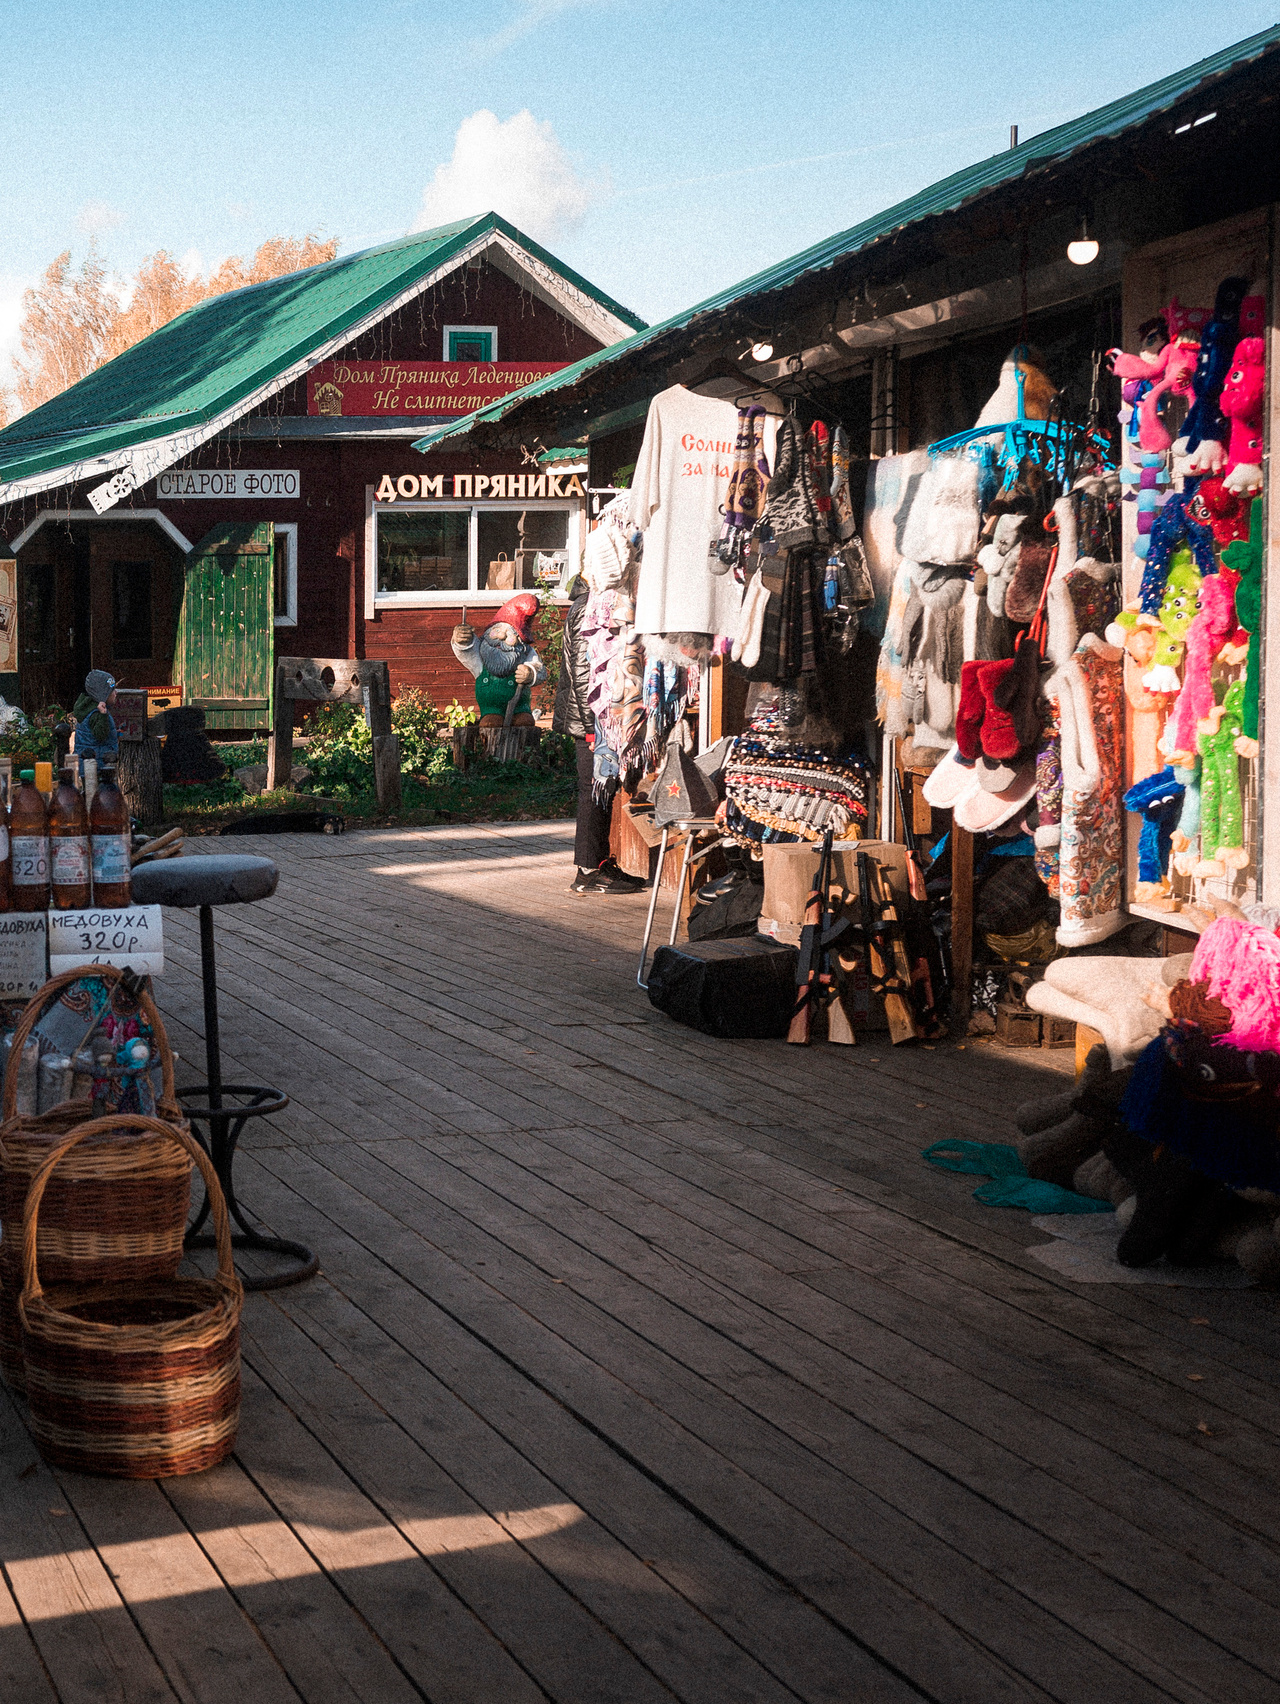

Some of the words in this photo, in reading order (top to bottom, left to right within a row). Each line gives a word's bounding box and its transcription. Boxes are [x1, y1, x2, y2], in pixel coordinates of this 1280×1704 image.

[334, 366, 375, 383] Дом
[379, 364, 460, 389] Пряника
[372, 389, 400, 409] Не
[404, 391, 509, 409] слипнется
[681, 433, 737, 455] Солнц
[159, 473, 236, 495] СТАРОЕ
[243, 474, 297, 495] ФОТО
[374, 474, 444, 503] ДОМ
[452, 474, 586, 499] ПРЯНИКА
[147, 687, 180, 695] НИМАНИЕ
[14, 859, 47, 876] 320
[52, 913, 149, 930] МЕДОВУХА
